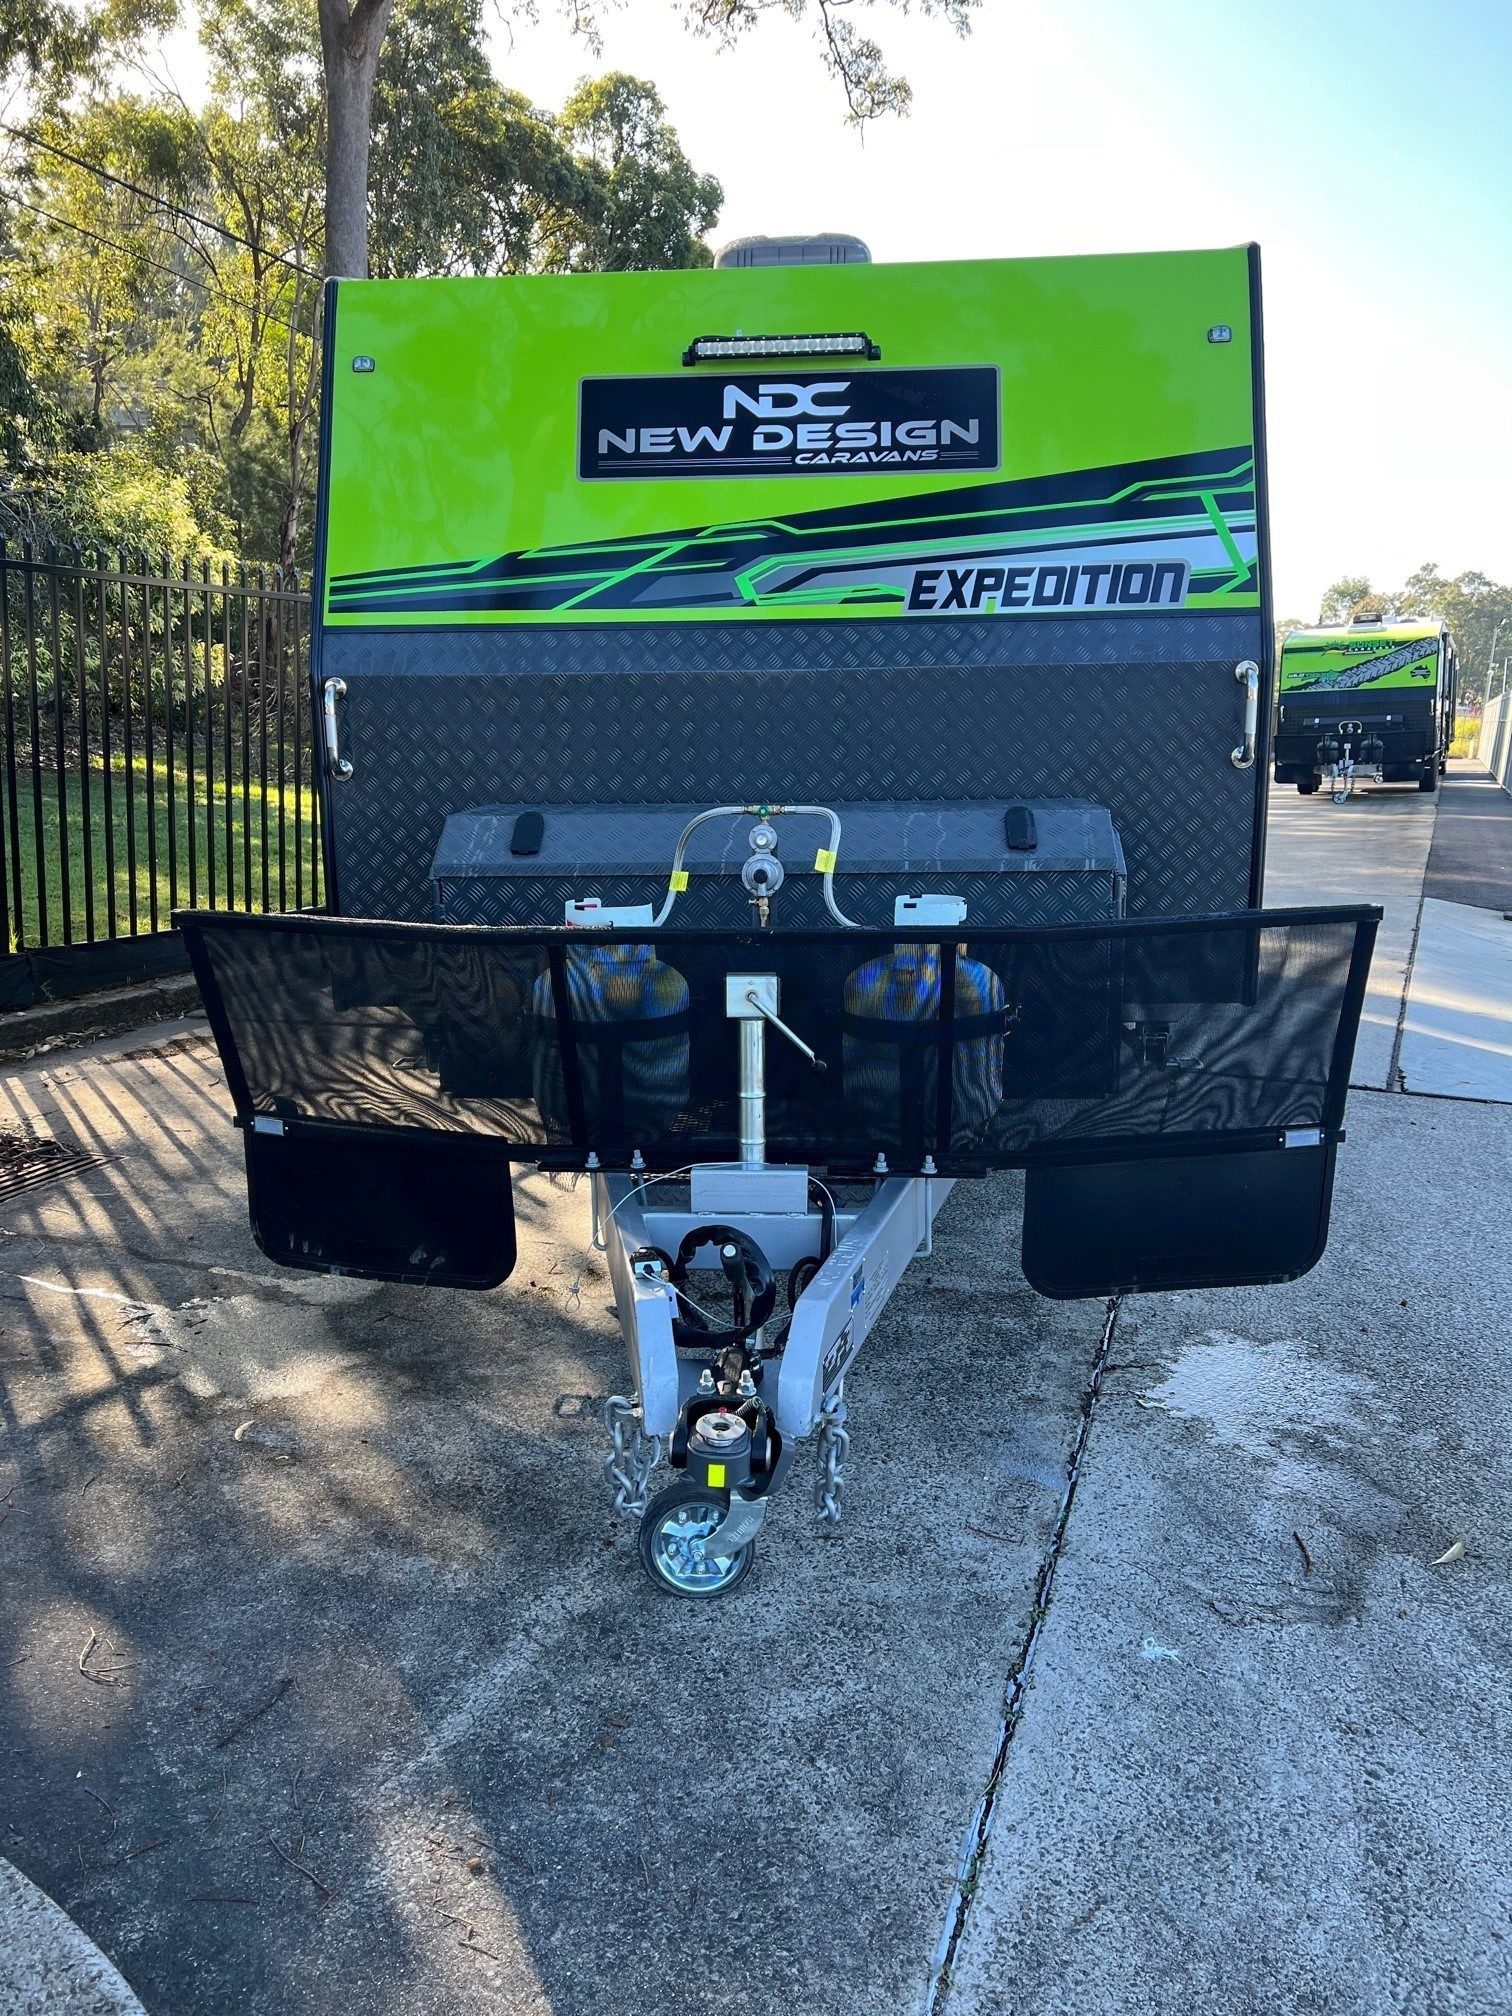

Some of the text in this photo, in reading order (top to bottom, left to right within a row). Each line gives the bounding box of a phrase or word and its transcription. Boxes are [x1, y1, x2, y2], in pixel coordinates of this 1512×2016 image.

[723, 381, 851, 419] NDC
[598, 418, 980, 454] NEW DESIGN
[794, 449, 940, 466] CARAVANS
[907, 562, 1186, 611] EXPEDITION
[1349, 639, 1395, 649] SUNSET
